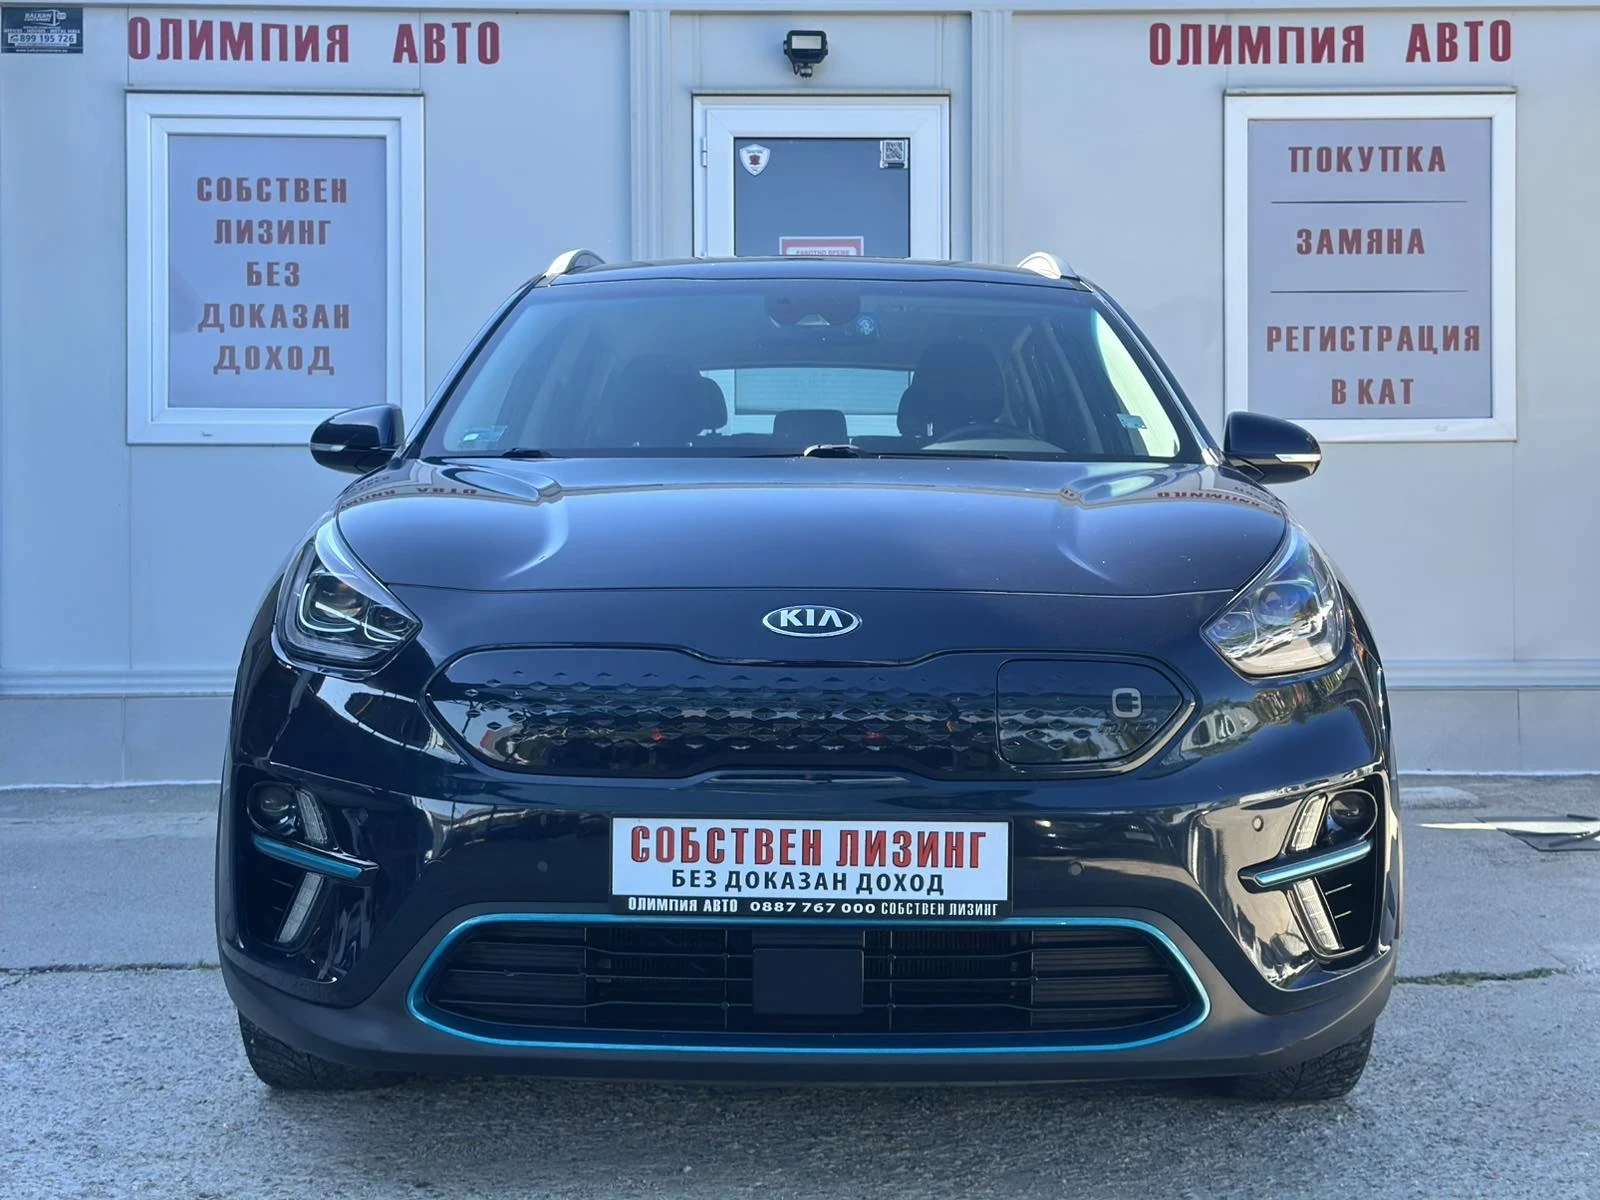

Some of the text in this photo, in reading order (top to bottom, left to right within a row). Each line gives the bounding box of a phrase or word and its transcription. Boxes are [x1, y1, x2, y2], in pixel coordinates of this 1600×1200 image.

[20, 34, 37, 43] 899
[40, 35, 55, 43] 195
[58, 35, 74, 43] 726
[128, 16, 500, 65] ОЛИМПИЯ АВТО
[1149, 19, 1511, 66] ОЛИМПИЯ АВТО
[1288, 145, 1446, 173] ПОКУПКА
[196, 176, 347, 203] СОБСТВЕН
[214, 219, 332, 245] ЛИЗИНГ
[1296, 228, 1425, 256] ЗАМЯНА
[246, 262, 300, 287] БЕЗ
[197, 303, 350, 333] ДОКАЗАН
[1266, 325, 1480, 355] РЕГИСТРАЦИЯ
[213, 345, 335, 376] ДОХОД
[1331, 378, 1415, 405] В КАТ
[780, 608, 843, 628] KIA
[630, 825, 987, 869] СОБСТВЕН ЛИЗИНГ
[671, 869, 944, 896] БЕЗ ДОКАЗАН ДОХОД
[628, 896, 999, 917] ОЛИМПИЯ АВТО 0887 767 000 СОБСТВЕН ЛИЗИНГ
